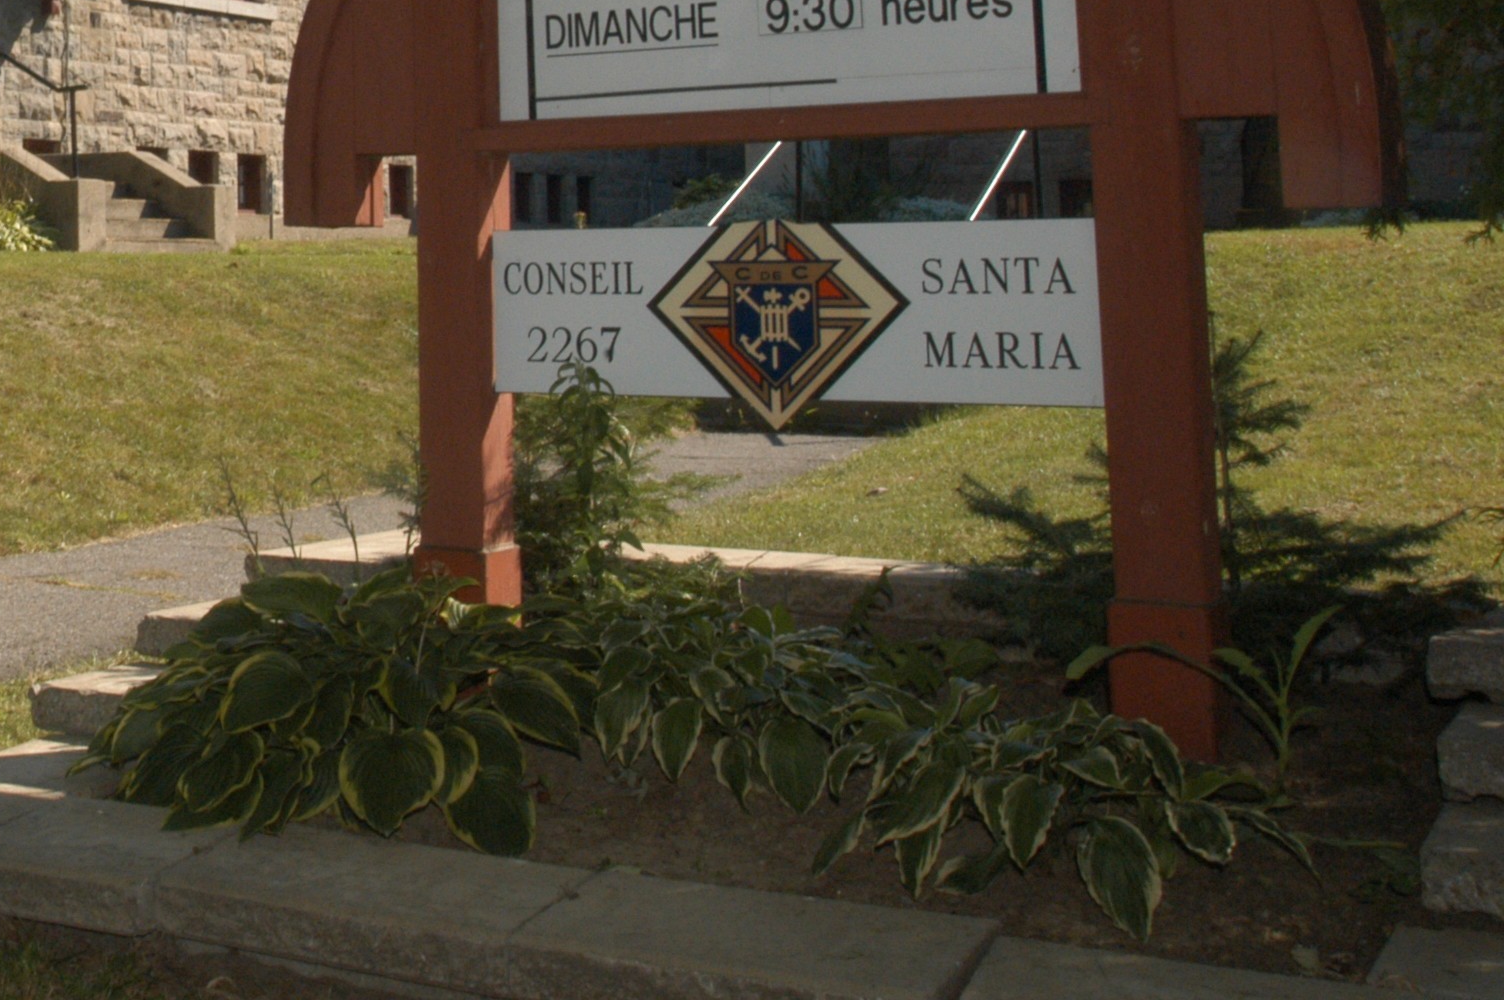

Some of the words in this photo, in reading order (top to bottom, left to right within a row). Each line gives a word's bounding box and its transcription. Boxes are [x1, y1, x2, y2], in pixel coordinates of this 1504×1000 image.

[545, 2, 719, 50] DIMANCHE
[503, 261, 644, 296] CONSEIL
[921, 257, 1077, 295] SANTA
[527, 327, 622, 364] 2267
[924, 331, 1082, 370] MARIA
